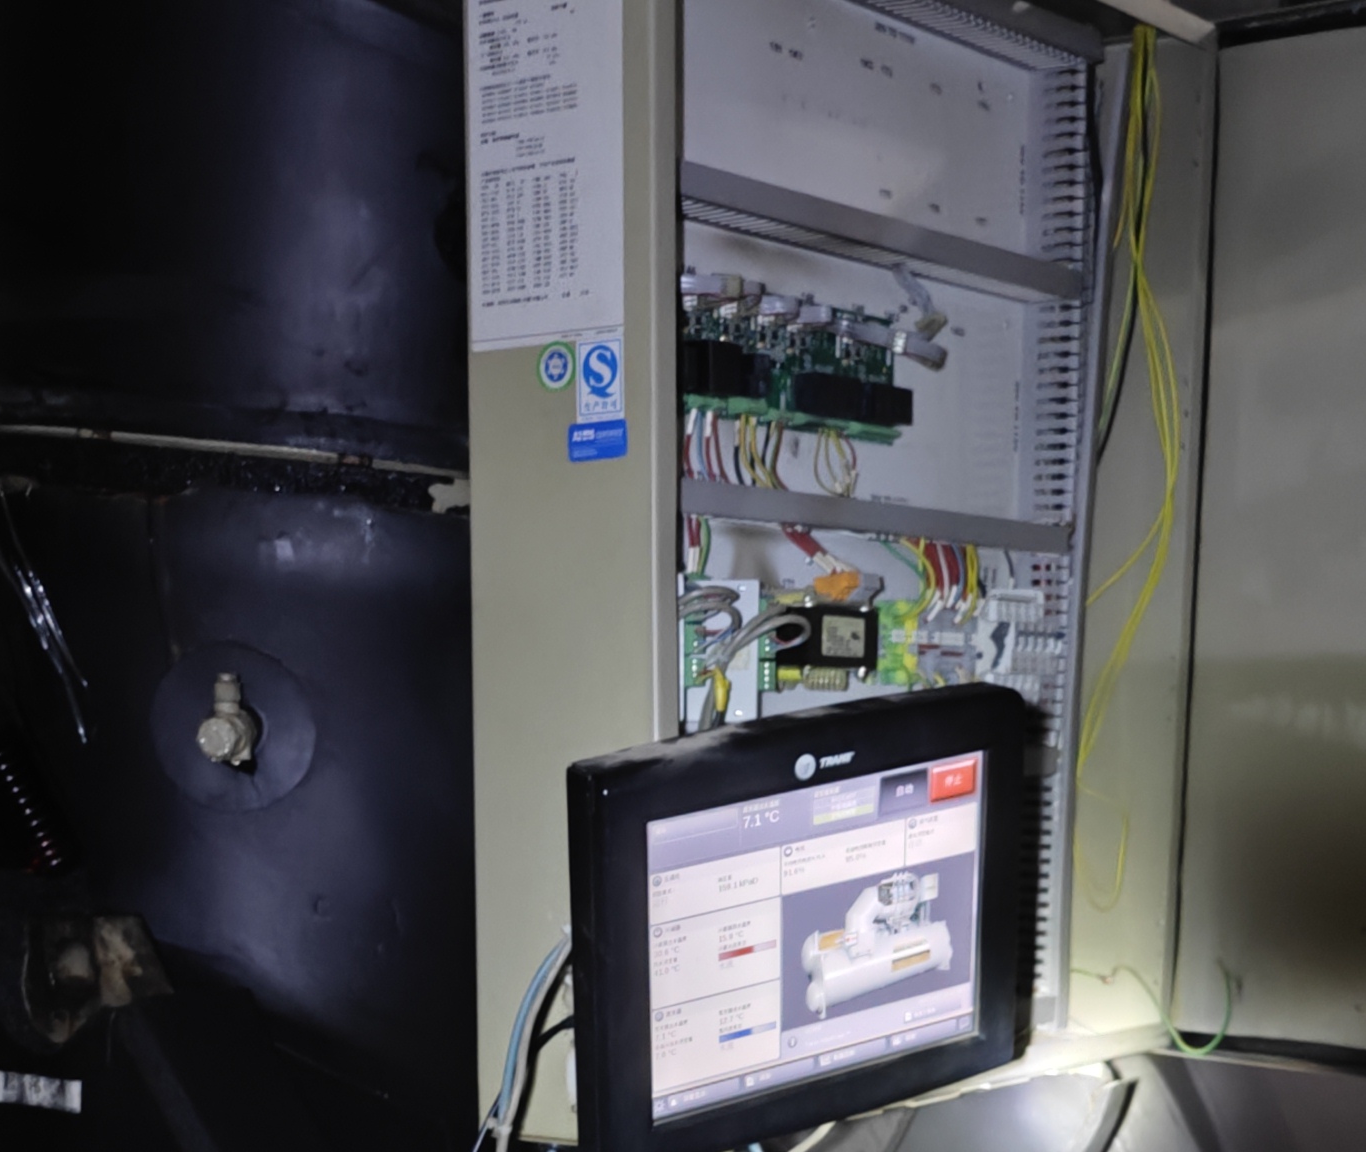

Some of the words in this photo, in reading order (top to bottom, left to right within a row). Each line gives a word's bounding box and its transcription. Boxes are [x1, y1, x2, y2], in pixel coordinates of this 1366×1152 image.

[944, 774, 962, 787] 停止
[895, 783, 914, 797] 自动
[742, 813, 762, 829] 7.1
